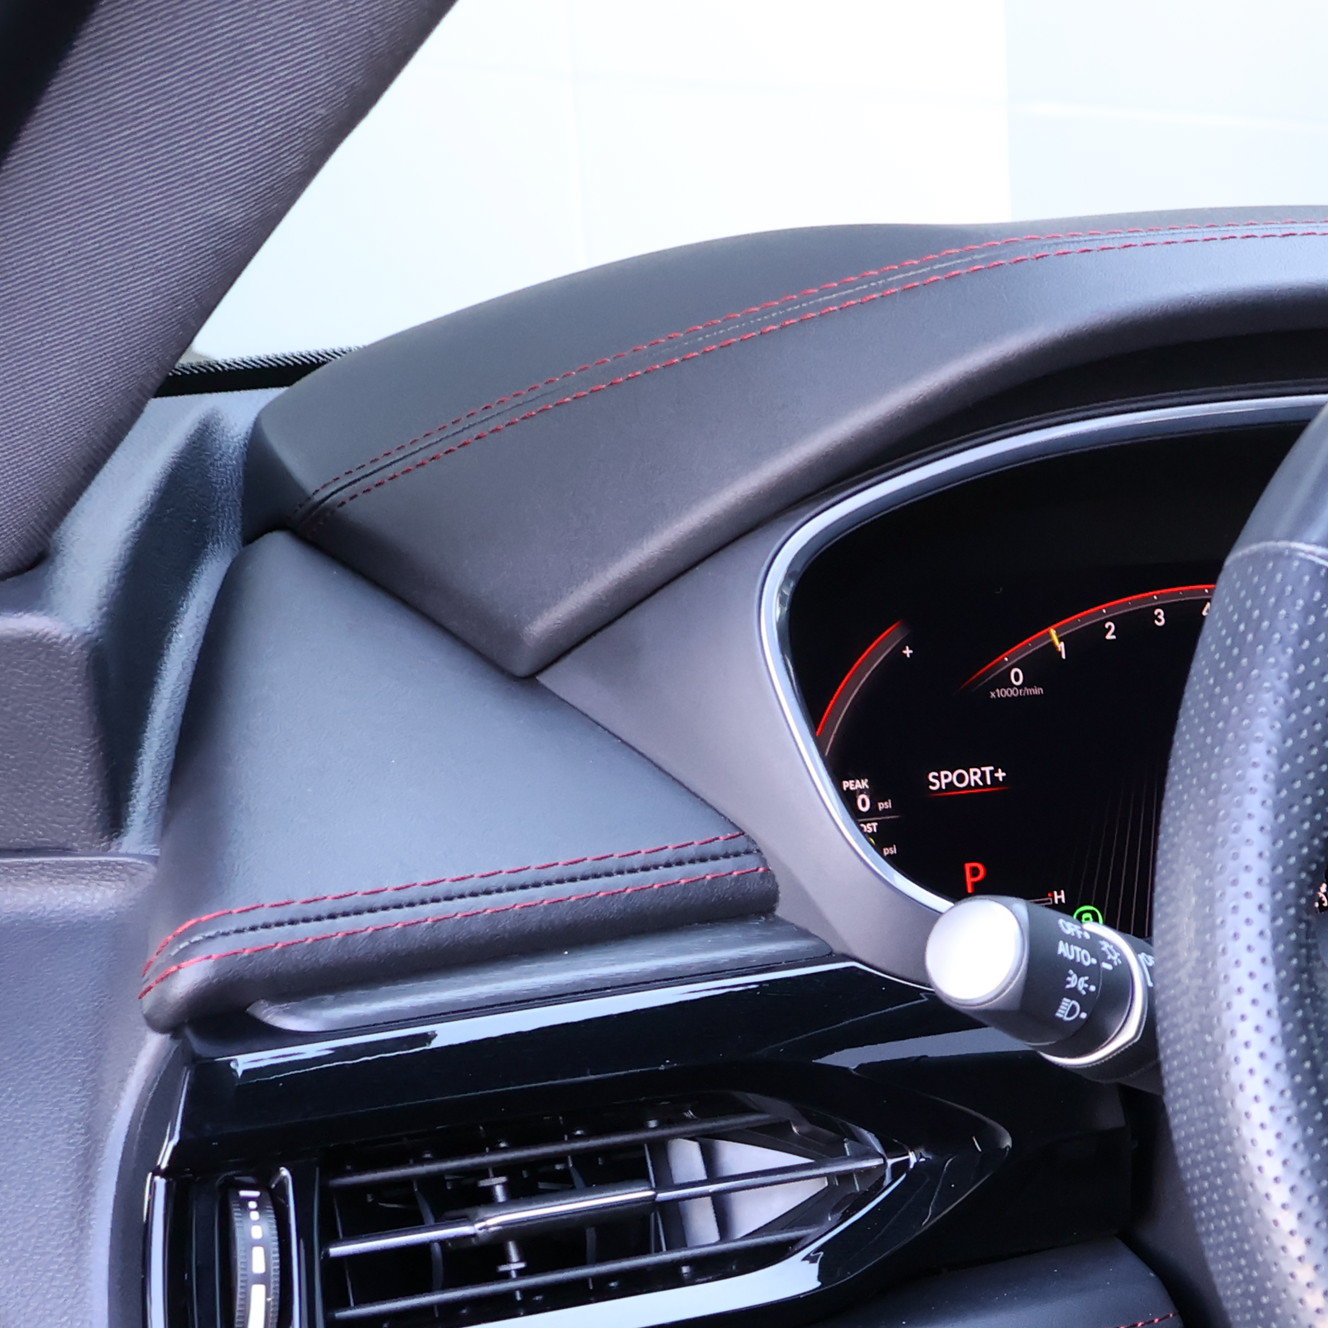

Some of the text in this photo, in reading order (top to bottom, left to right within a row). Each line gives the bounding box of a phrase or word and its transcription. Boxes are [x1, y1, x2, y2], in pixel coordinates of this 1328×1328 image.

[1154, 608, 1165, 626] 3
[1104, 621, 1116, 640] 2
[1010, 667, 1024, 686] 0
[842, 778, 869, 791] PEAK
[928, 766, 1006, 790] SPORT+
[856, 793, 892, 812] 0 psi
[883, 845, 897, 857] psi
[963, 861, 987, 893] P
[1053, 890, 1065, 905] H
[1058, 919, 1082, 939] OFF
[1057, 941, 1091, 966] AUTO
